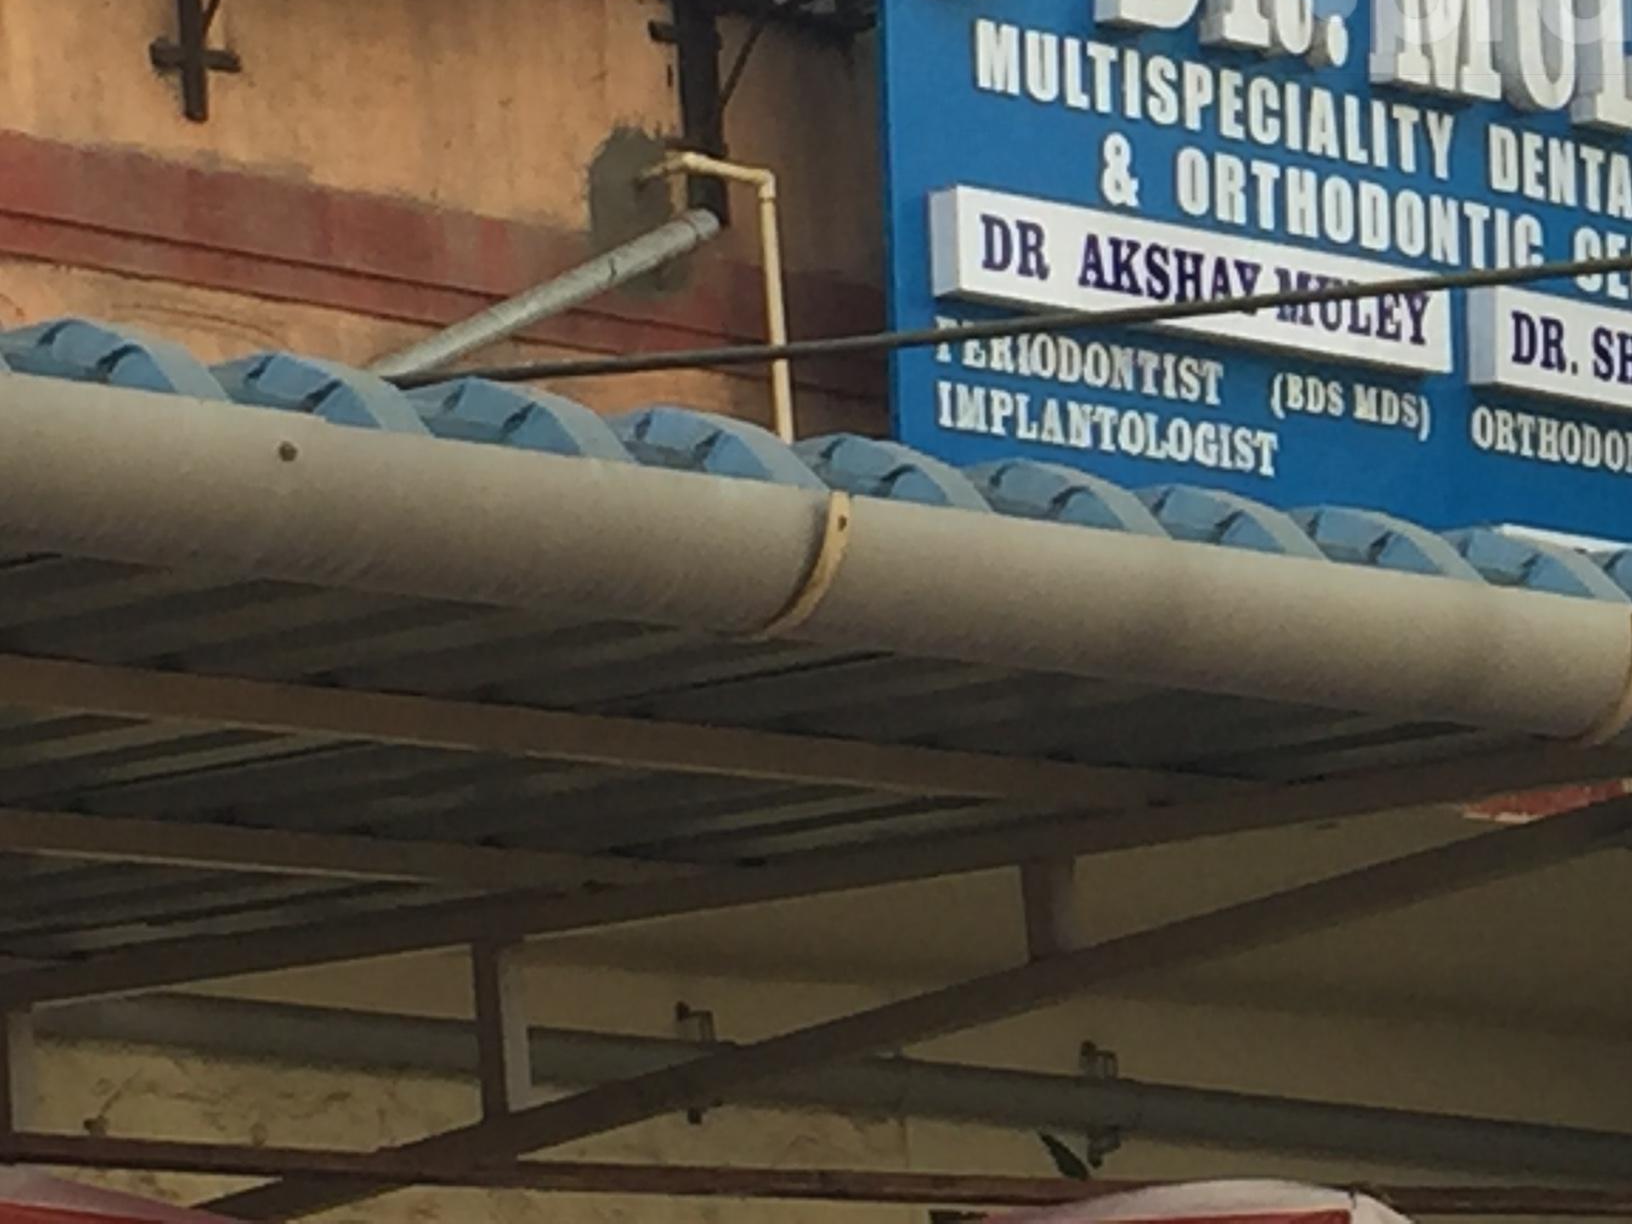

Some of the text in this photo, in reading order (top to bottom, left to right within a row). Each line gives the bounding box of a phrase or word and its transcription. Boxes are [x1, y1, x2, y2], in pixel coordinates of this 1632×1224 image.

[974, 18, 1454, 180] MULTISPECIALITY
[1102, 132, 1140, 208] &
[1175, 146, 1546, 272] ORTHODONTIC
[980, 213, 1431, 346] DR AKSHAY MULEY
[1511, 309, 1578, 376] DR.
[936, 379, 1279, 477] IMPLANTOLOGIST
[1270, 372, 1345, 420] (BDS
[1353, 382, 1430, 442] MDS)
